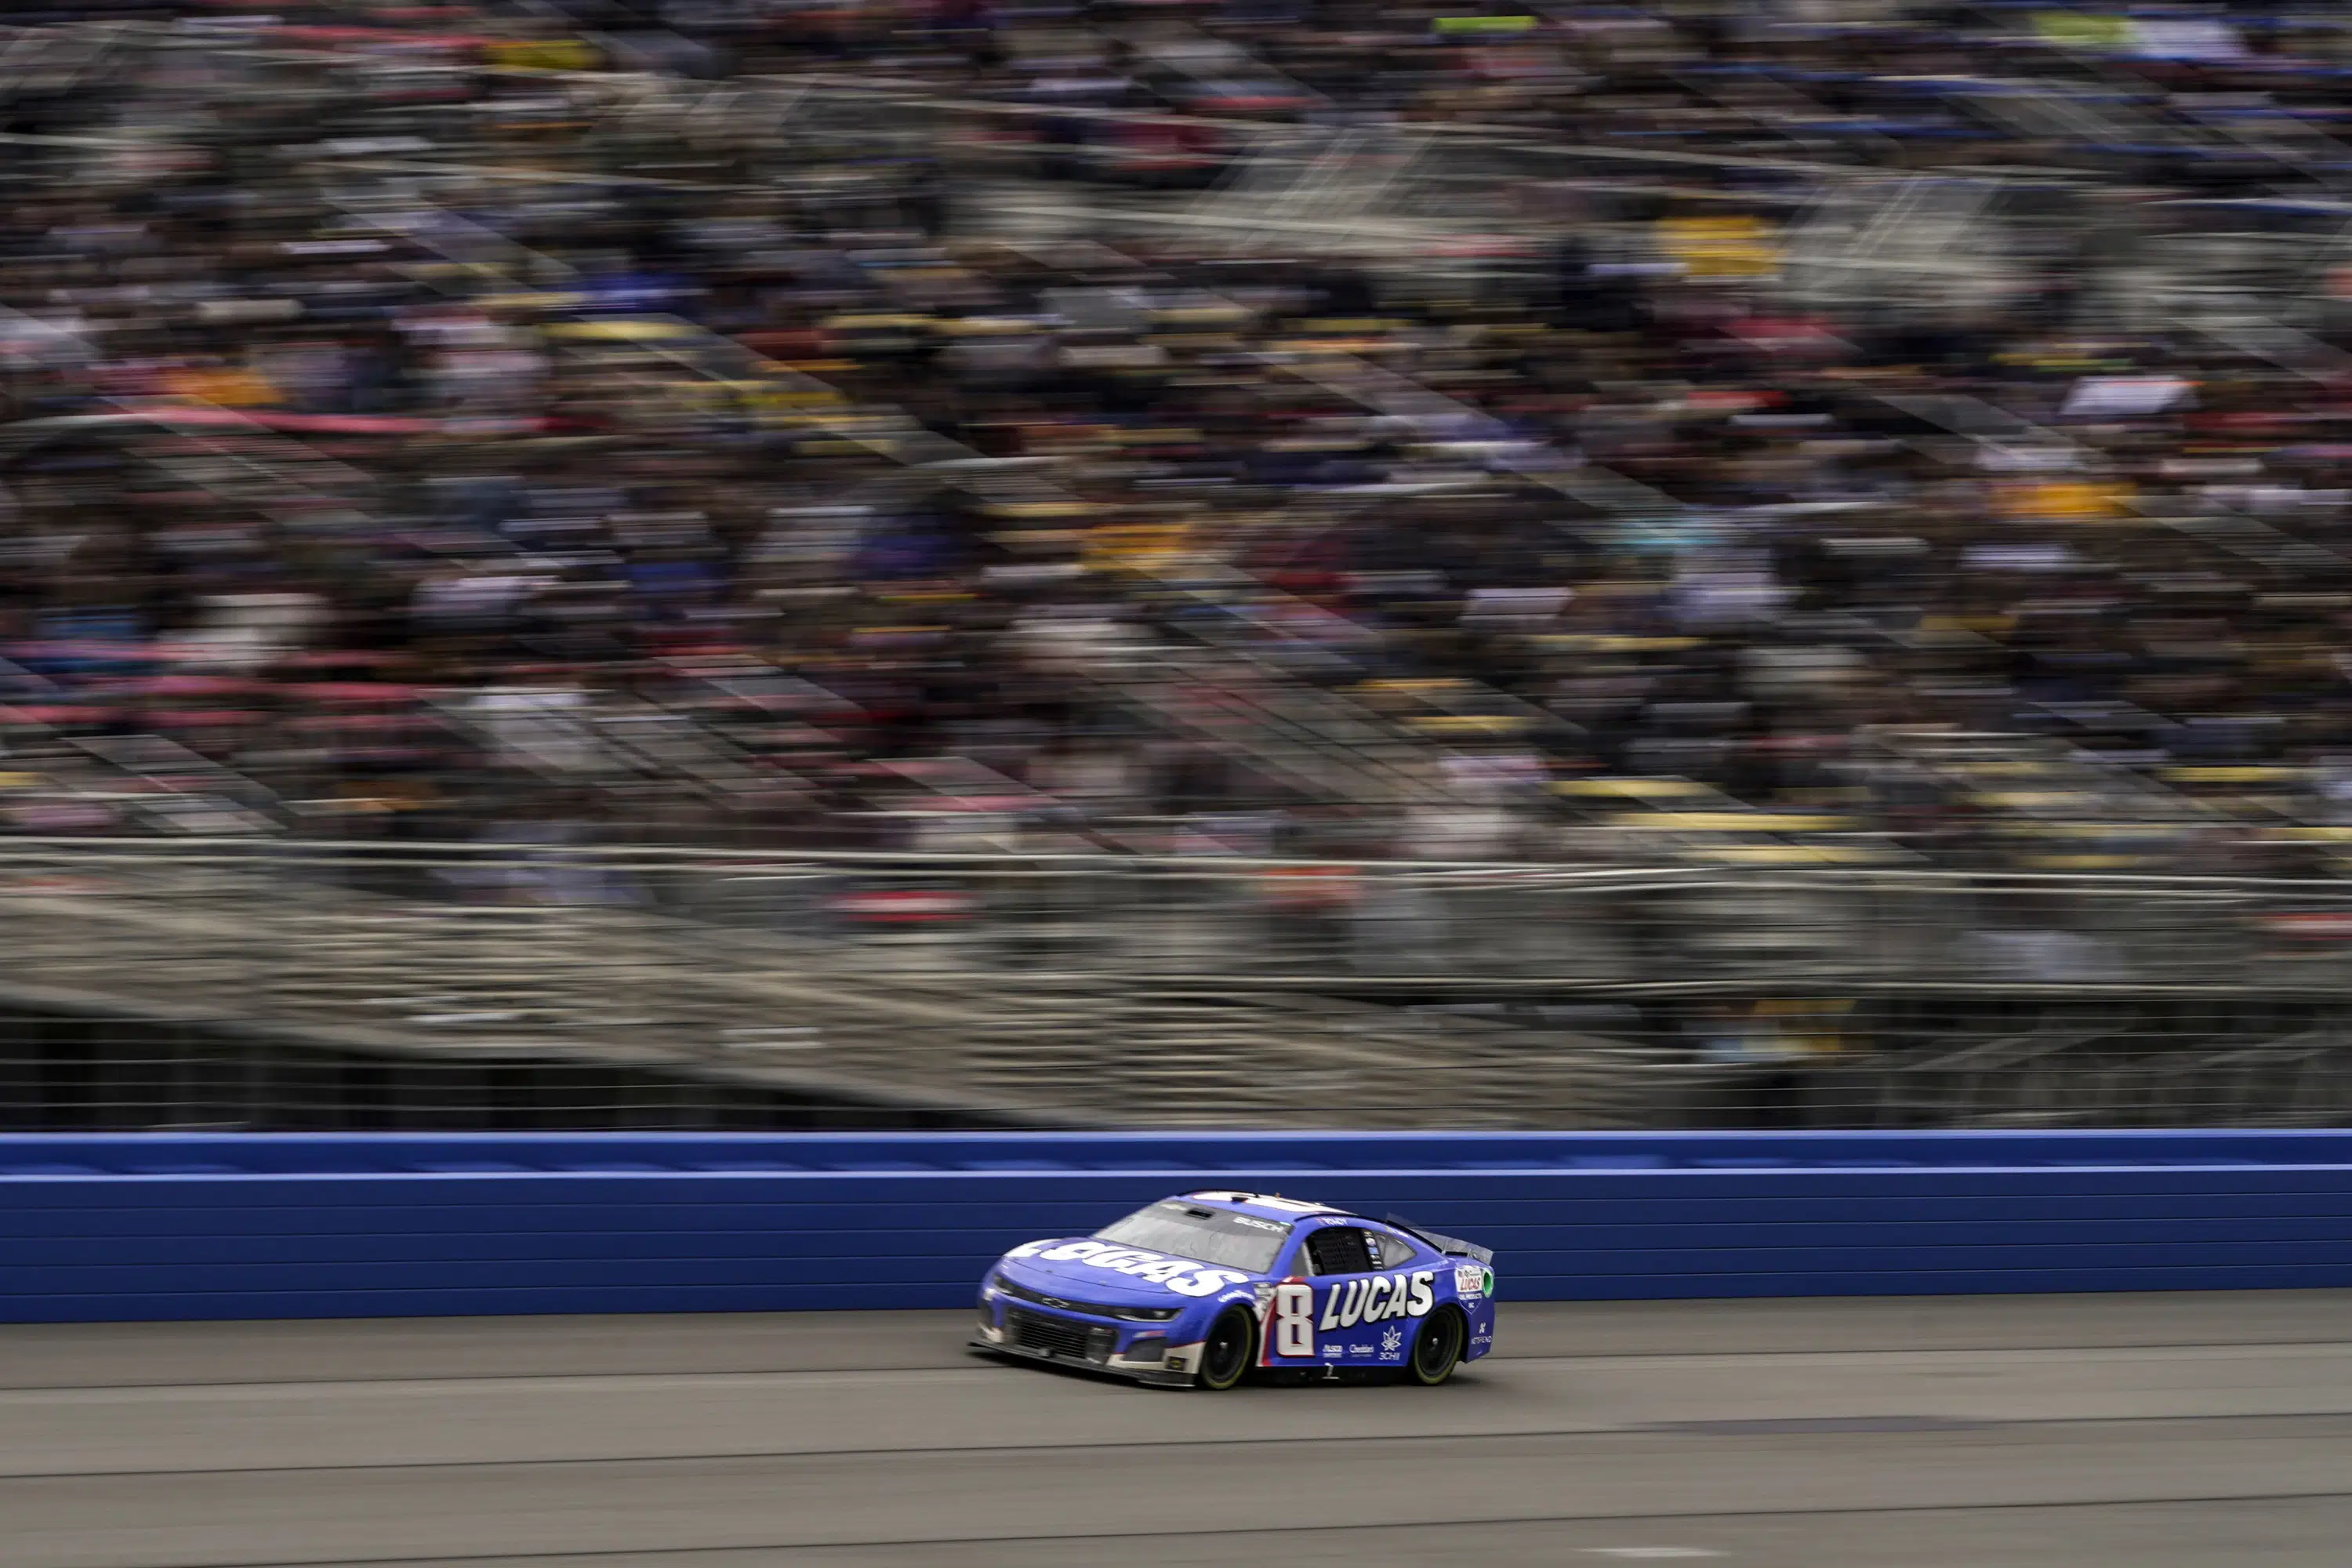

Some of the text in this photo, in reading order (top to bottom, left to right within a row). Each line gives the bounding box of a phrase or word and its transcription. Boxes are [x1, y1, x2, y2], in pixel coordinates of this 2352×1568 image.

[1232, 1216, 1283, 1233] BUSCH
[1004, 1238, 1250, 1298] LUCAS
[1460, 1277, 1481, 1290] LUCAS
[1276, 1283, 1315, 1356] 8
[1319, 1271, 1434, 1331] LUCAS
